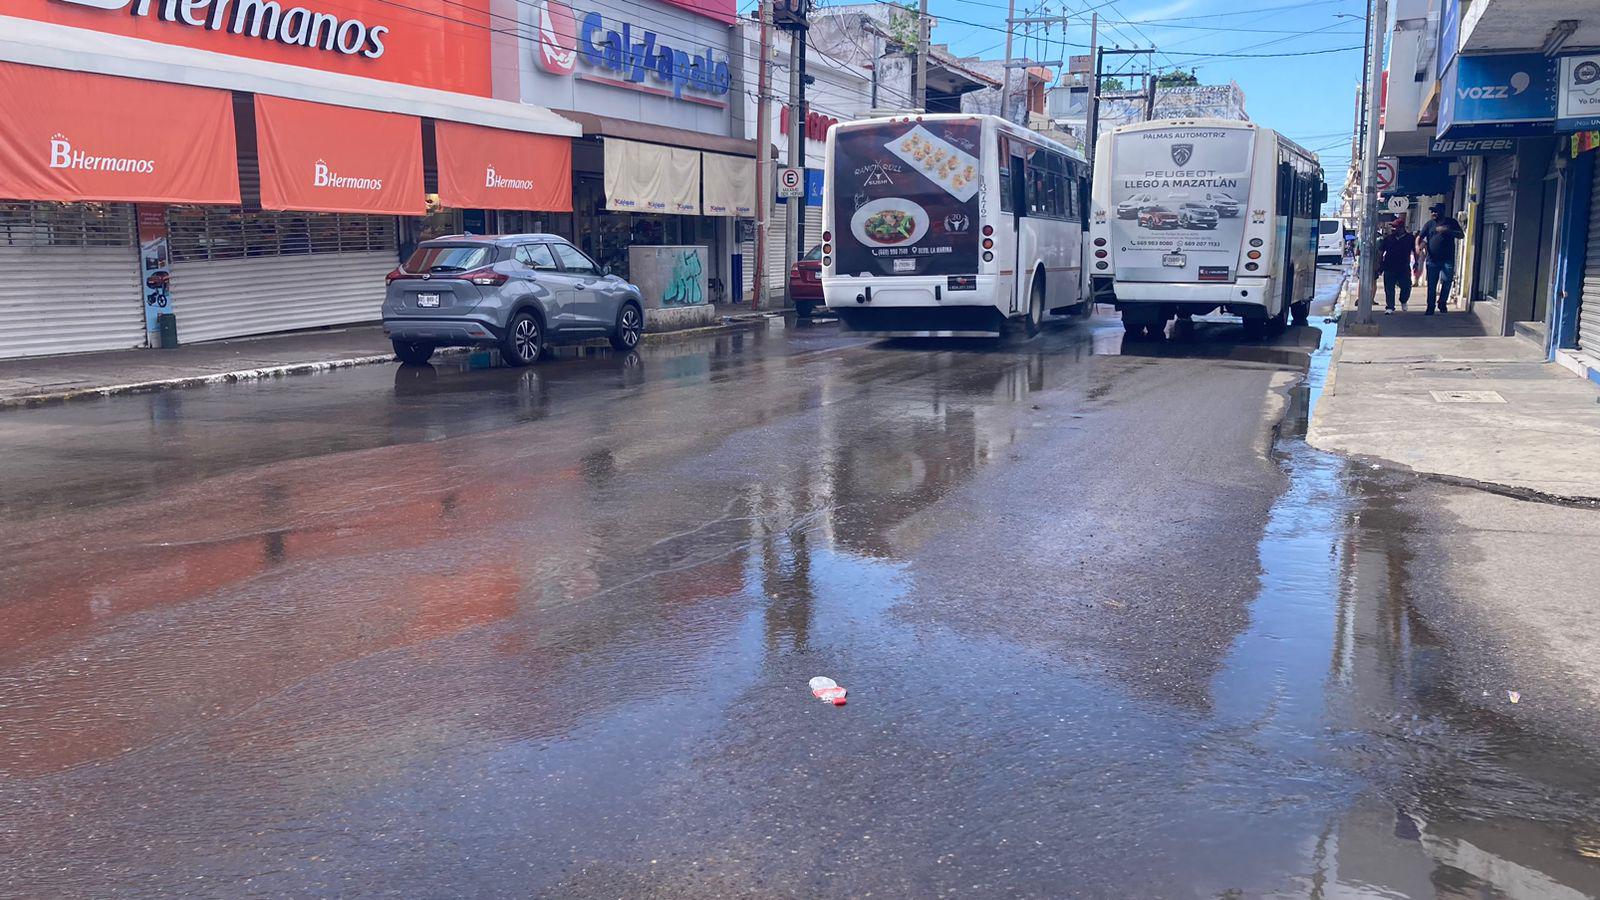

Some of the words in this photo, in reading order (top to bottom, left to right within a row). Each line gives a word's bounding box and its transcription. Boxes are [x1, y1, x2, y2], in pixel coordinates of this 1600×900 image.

[1145, 170, 1216, 178] PEUGEOT
[787, 173, 794, 184] E
[1162, 180, 1170, 188] A
